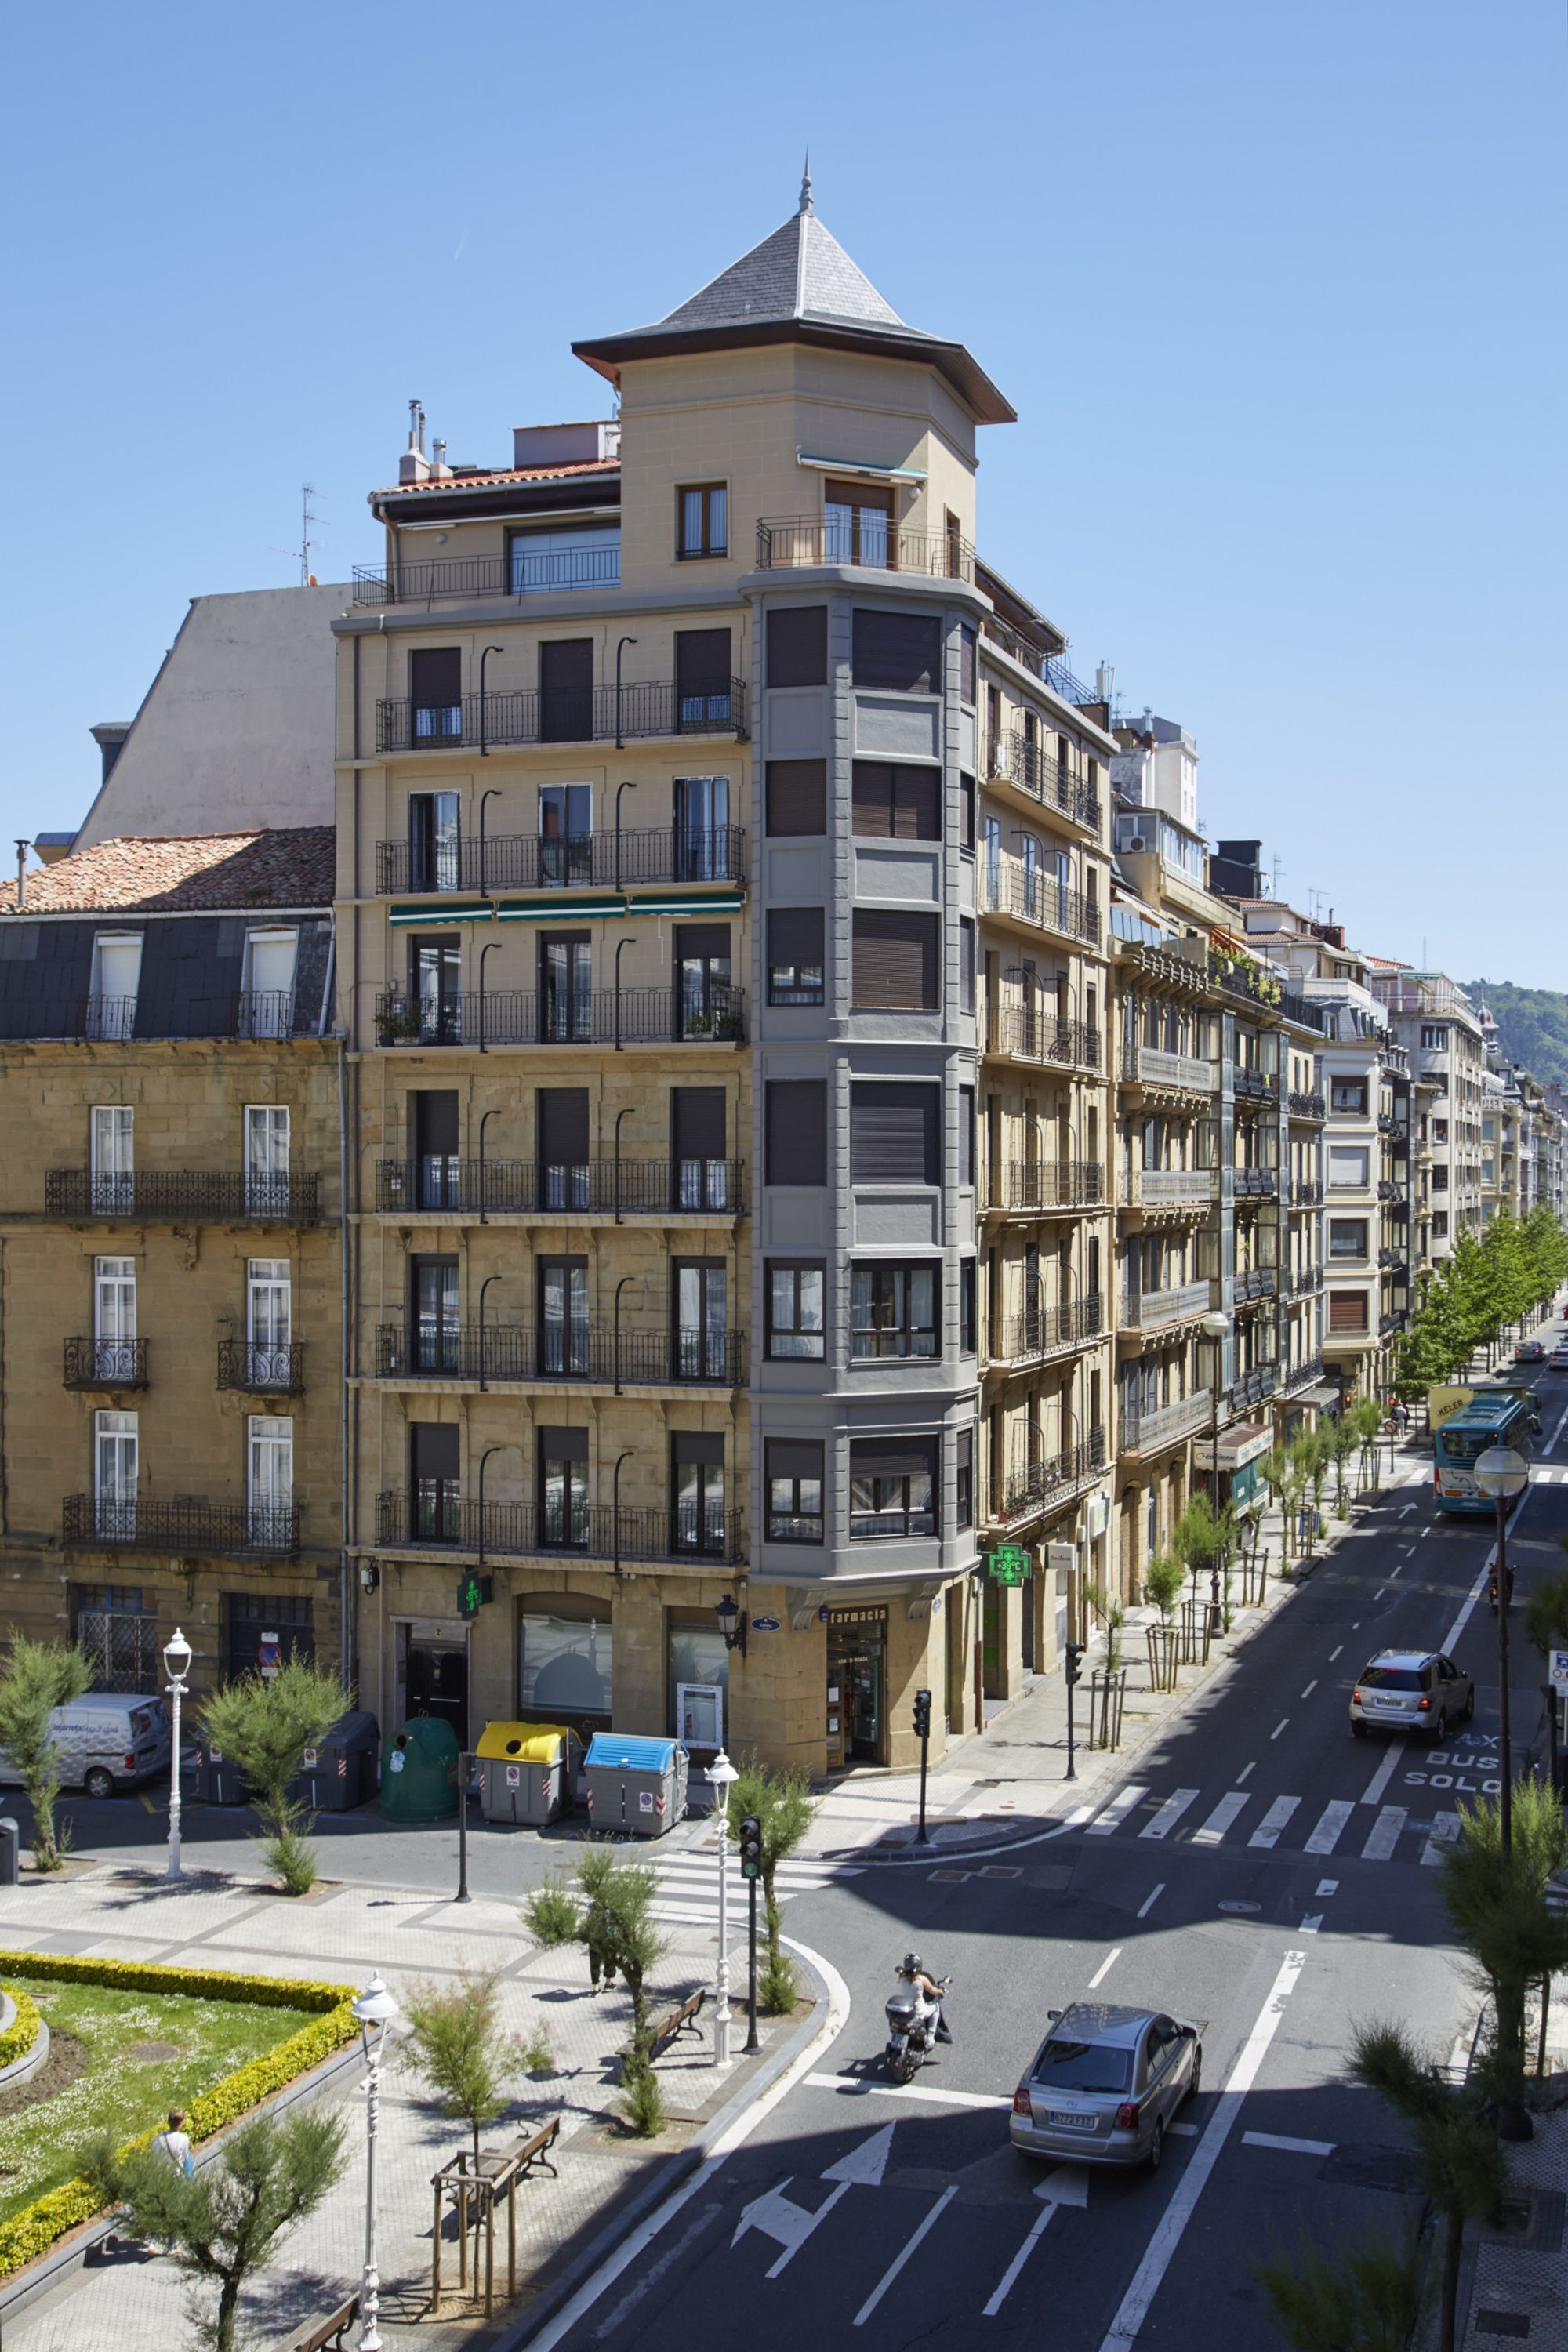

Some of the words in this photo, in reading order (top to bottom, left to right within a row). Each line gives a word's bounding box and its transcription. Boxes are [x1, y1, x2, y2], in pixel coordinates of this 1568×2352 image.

[1438, 1399, 1464, 1416] KELER
[830, 1609, 886, 1624] farmacia
[1425, 1751, 1500, 1769] BUS
